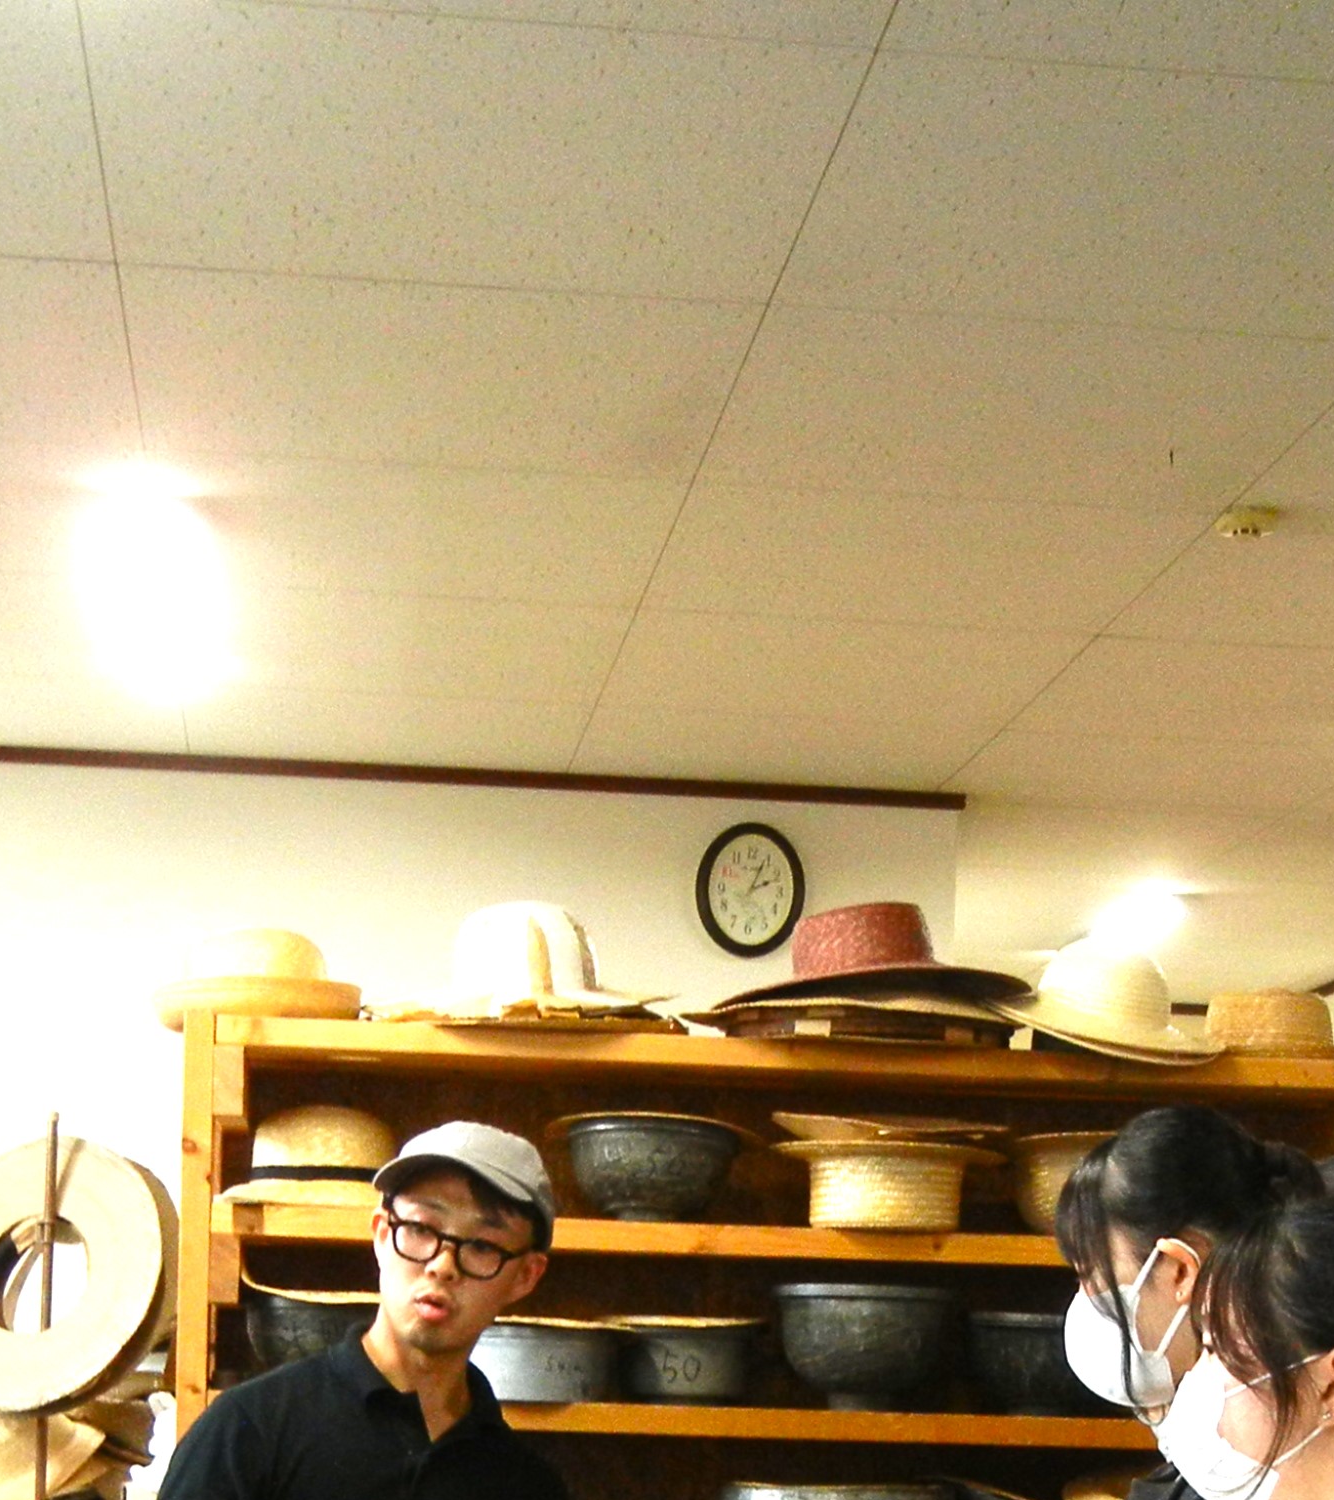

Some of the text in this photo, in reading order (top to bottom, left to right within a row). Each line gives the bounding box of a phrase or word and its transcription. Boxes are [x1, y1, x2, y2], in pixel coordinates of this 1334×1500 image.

[732, 850, 741, 864] 11
[747, 846, 758, 860] 12
[717, 882, 726, 895] 9
[775, 886, 784, 898] 3
[720, 900, 728, 912] 8
[730, 914, 737, 929] 7
[744, 923, 752, 935] 6
[661, 1349, 701, 1384] 50
